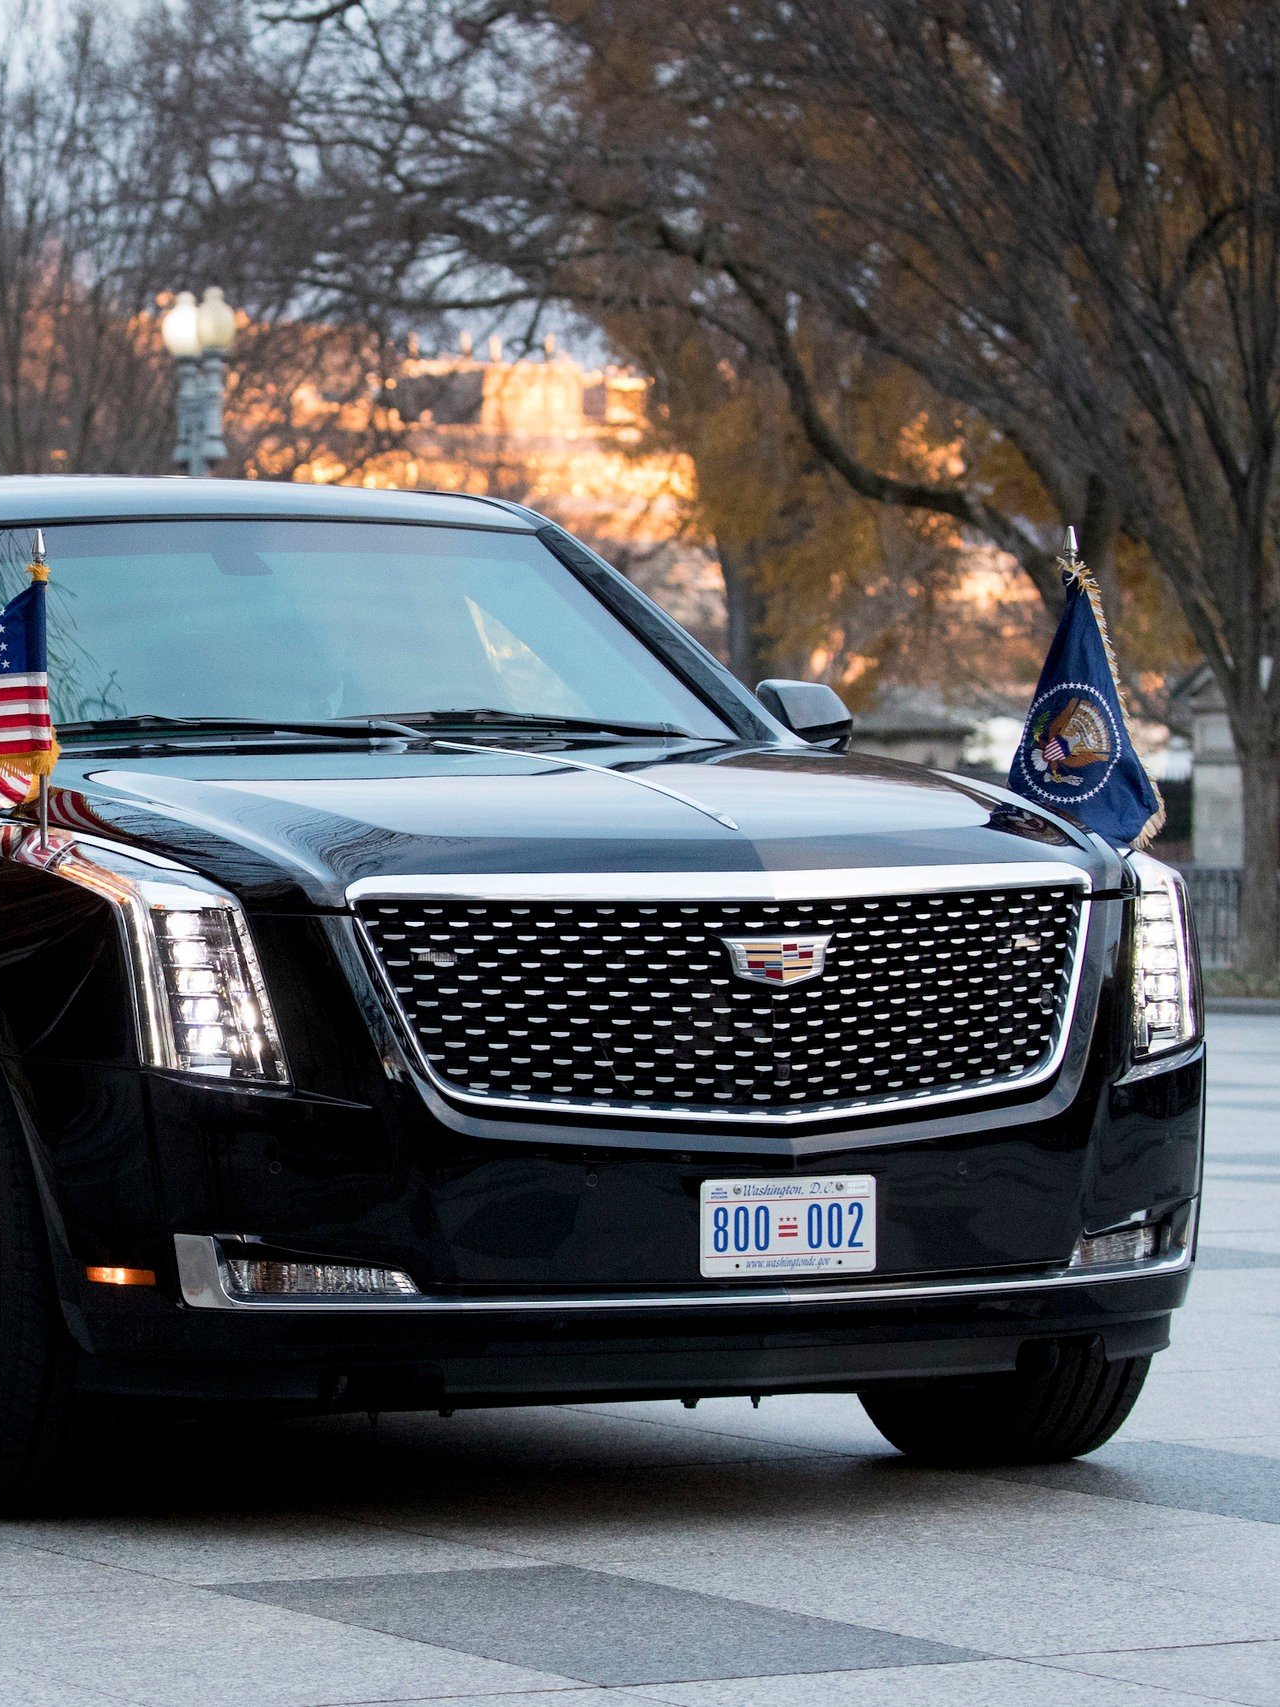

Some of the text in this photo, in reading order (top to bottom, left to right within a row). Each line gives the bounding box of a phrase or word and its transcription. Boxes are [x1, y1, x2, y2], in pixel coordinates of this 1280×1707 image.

[809, 1181, 834, 1194] D.C.
[713, 1201, 864, 1253] 800 002
[746, 1256, 831, 1270] www.washingtondc.gov
